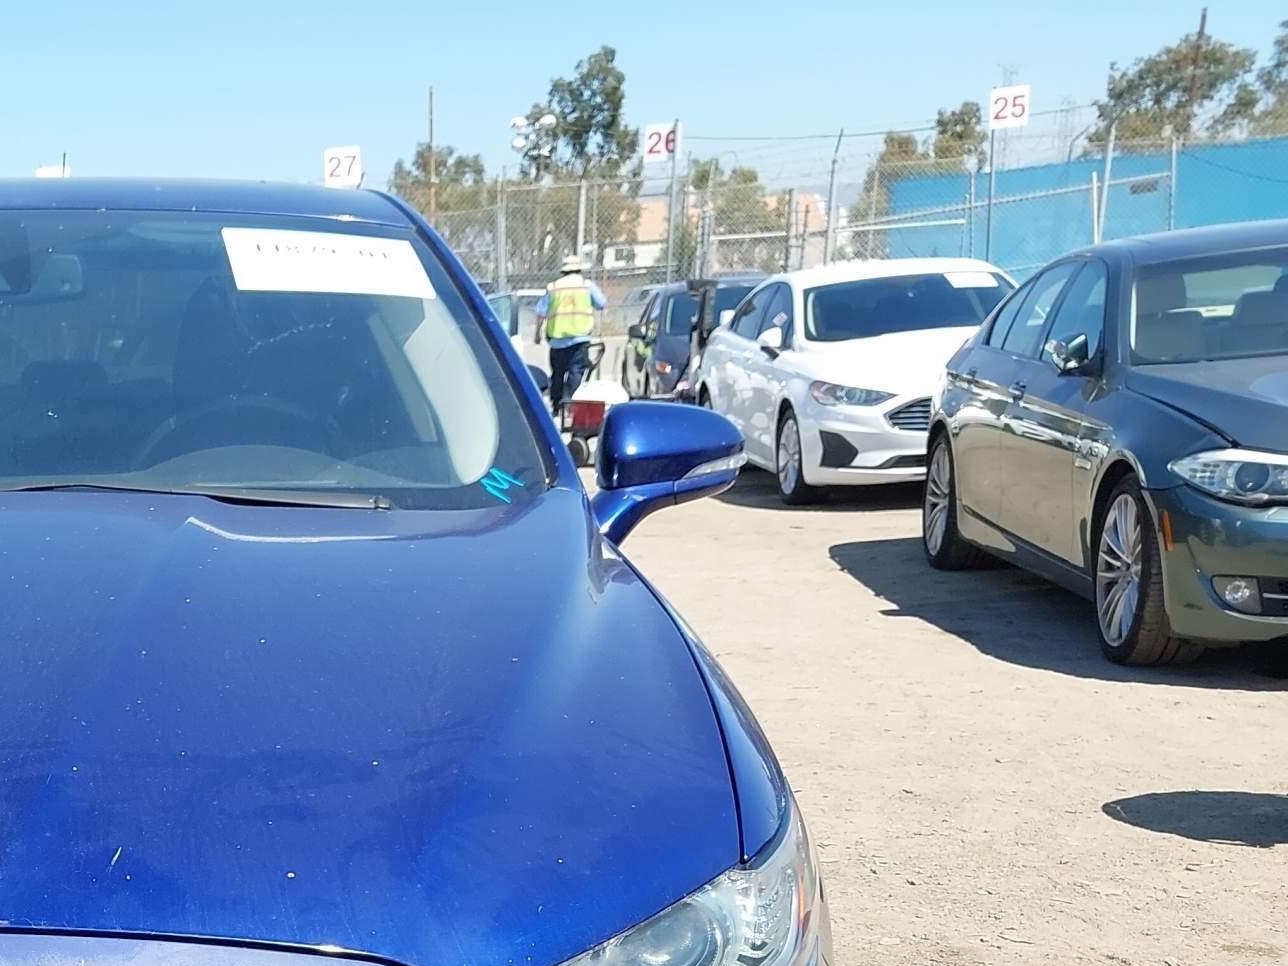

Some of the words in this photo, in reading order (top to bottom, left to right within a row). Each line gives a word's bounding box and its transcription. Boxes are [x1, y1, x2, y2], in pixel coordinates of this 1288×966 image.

[993, 95, 1026, 120] 25
[647, 130, 676, 154] 26
[328, 155, 357, 177] 27
